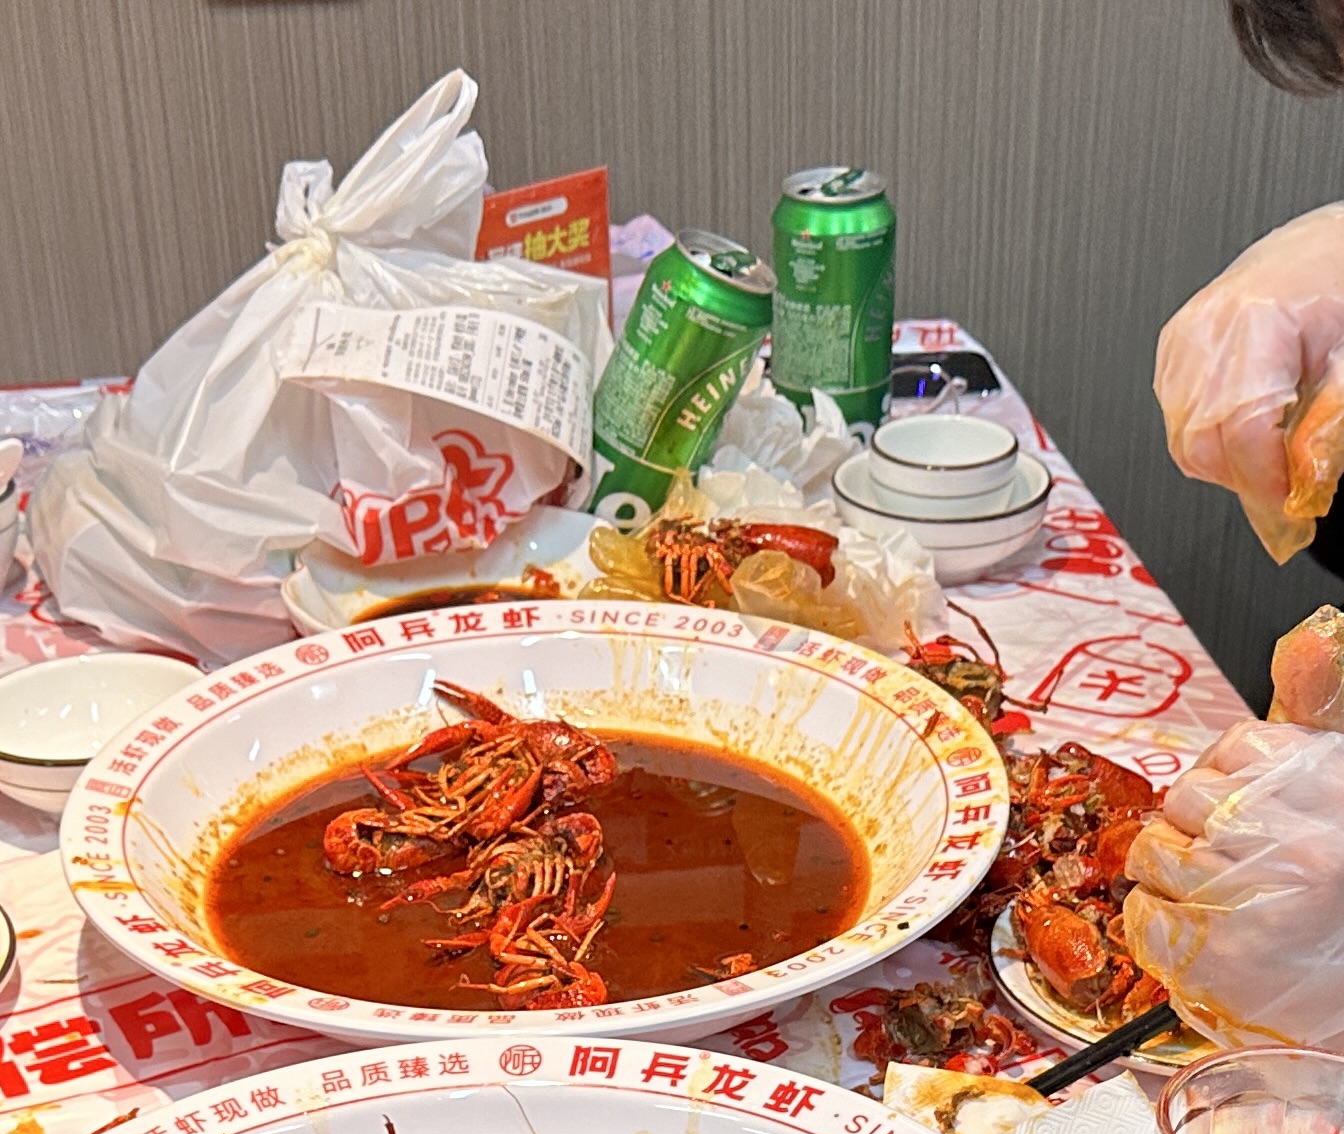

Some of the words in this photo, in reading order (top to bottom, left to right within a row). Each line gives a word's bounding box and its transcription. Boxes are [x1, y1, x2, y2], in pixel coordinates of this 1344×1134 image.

[343, 605, 541, 655] 阿兵龙虾
[569, 608, 661, 629] SINCE
[673, 615, 744, 639] 2003
[107, 716, 184, 777] 活虾现做
[187, 660, 286, 713] 品质臻选
[84, 804, 112, 846] 2003
[924, 771, 993, 884] 阿兵龙虾
[845, 894, 927, 943] SINCE
[114, 914, 296, 999] 阿兵龙虾
[765, 945, 844, 978] 2003
[320, 1052, 471, 1095] 品质臻选
[568, 1044, 826, 1118] 阿兵龙虾
